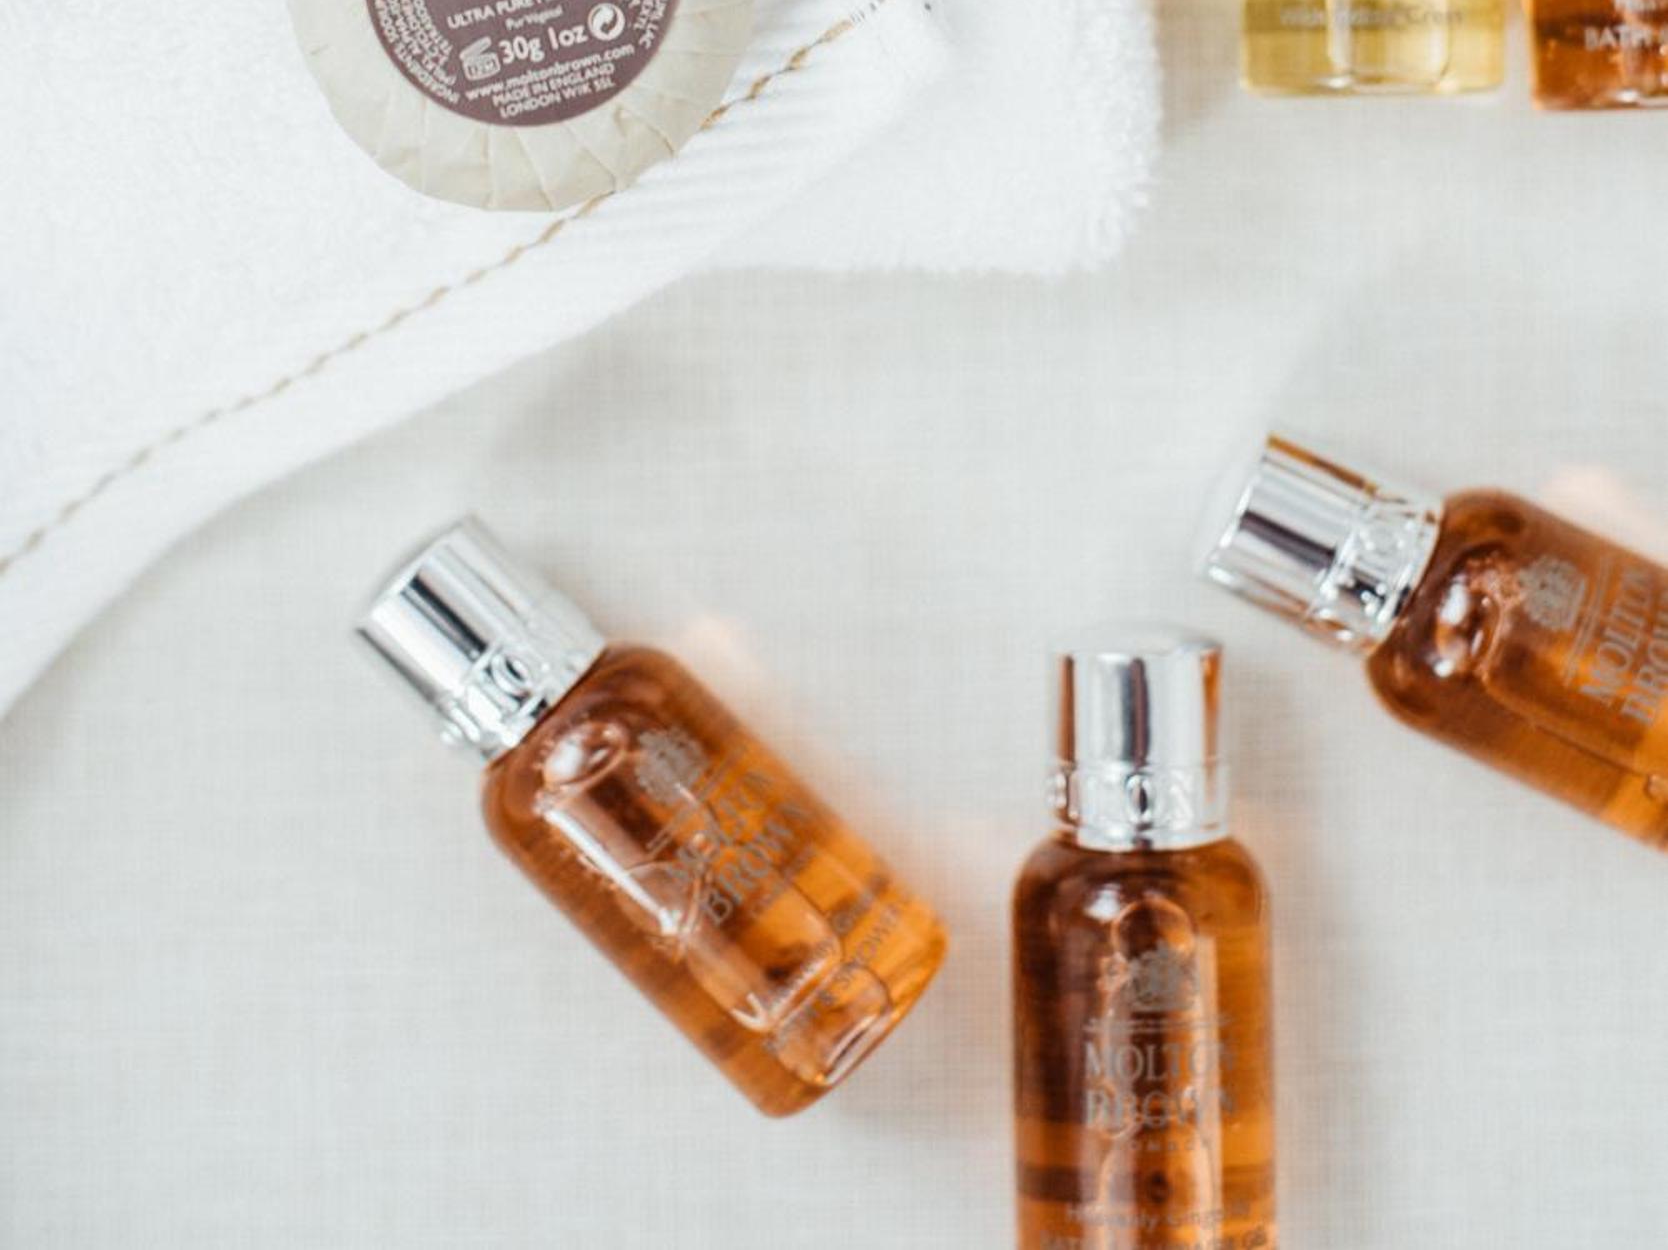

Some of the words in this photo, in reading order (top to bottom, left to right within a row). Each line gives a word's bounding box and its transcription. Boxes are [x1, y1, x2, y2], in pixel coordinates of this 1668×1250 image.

[447, 8, 496, 29] ULTRA
[499, 36, 545, 64] 30g
[465, 44, 635, 100] www.moltonbrown.com
[492, 84, 531, 107] MADE
[532, 80, 549, 94] IN
[549, 62, 616, 91] ENGLAND
[500, 91, 562, 120] LONDON
